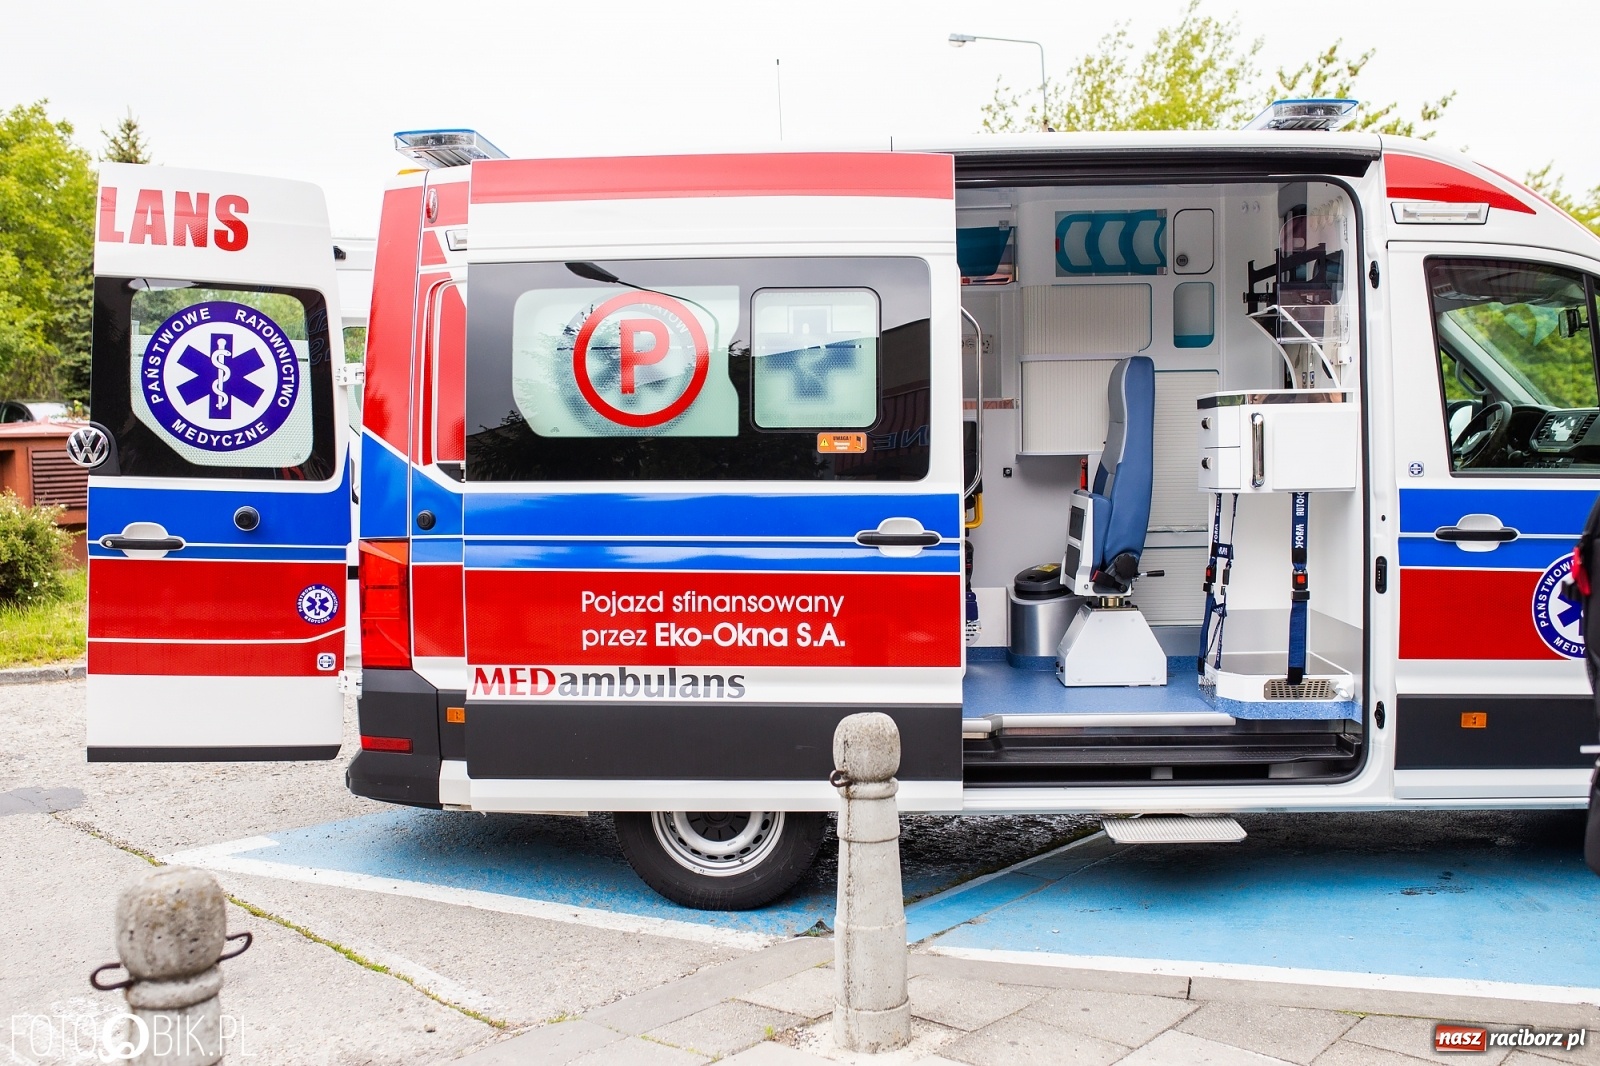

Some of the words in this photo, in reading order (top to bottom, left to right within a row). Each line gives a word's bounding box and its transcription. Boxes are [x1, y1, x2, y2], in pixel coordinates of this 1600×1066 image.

[98, 186, 249, 252] LANS
[143, 307, 211, 405] PAŃSTWOWE
[235, 309, 295, 409] RATOWNICTWO
[620, 318, 670, 395] P
[171, 418, 269, 447] MEDYCZNE
[581, 590, 664, 618] Pojazd
[671, 589, 845, 618] sfinansowany
[581, 628, 648, 651] przez
[655, 622, 788, 647] Eko-Okna
[796, 622, 846, 648] S.A.
[1553, 636, 1586, 655] MEDY
[471, 666, 746, 700] MEDambulans
